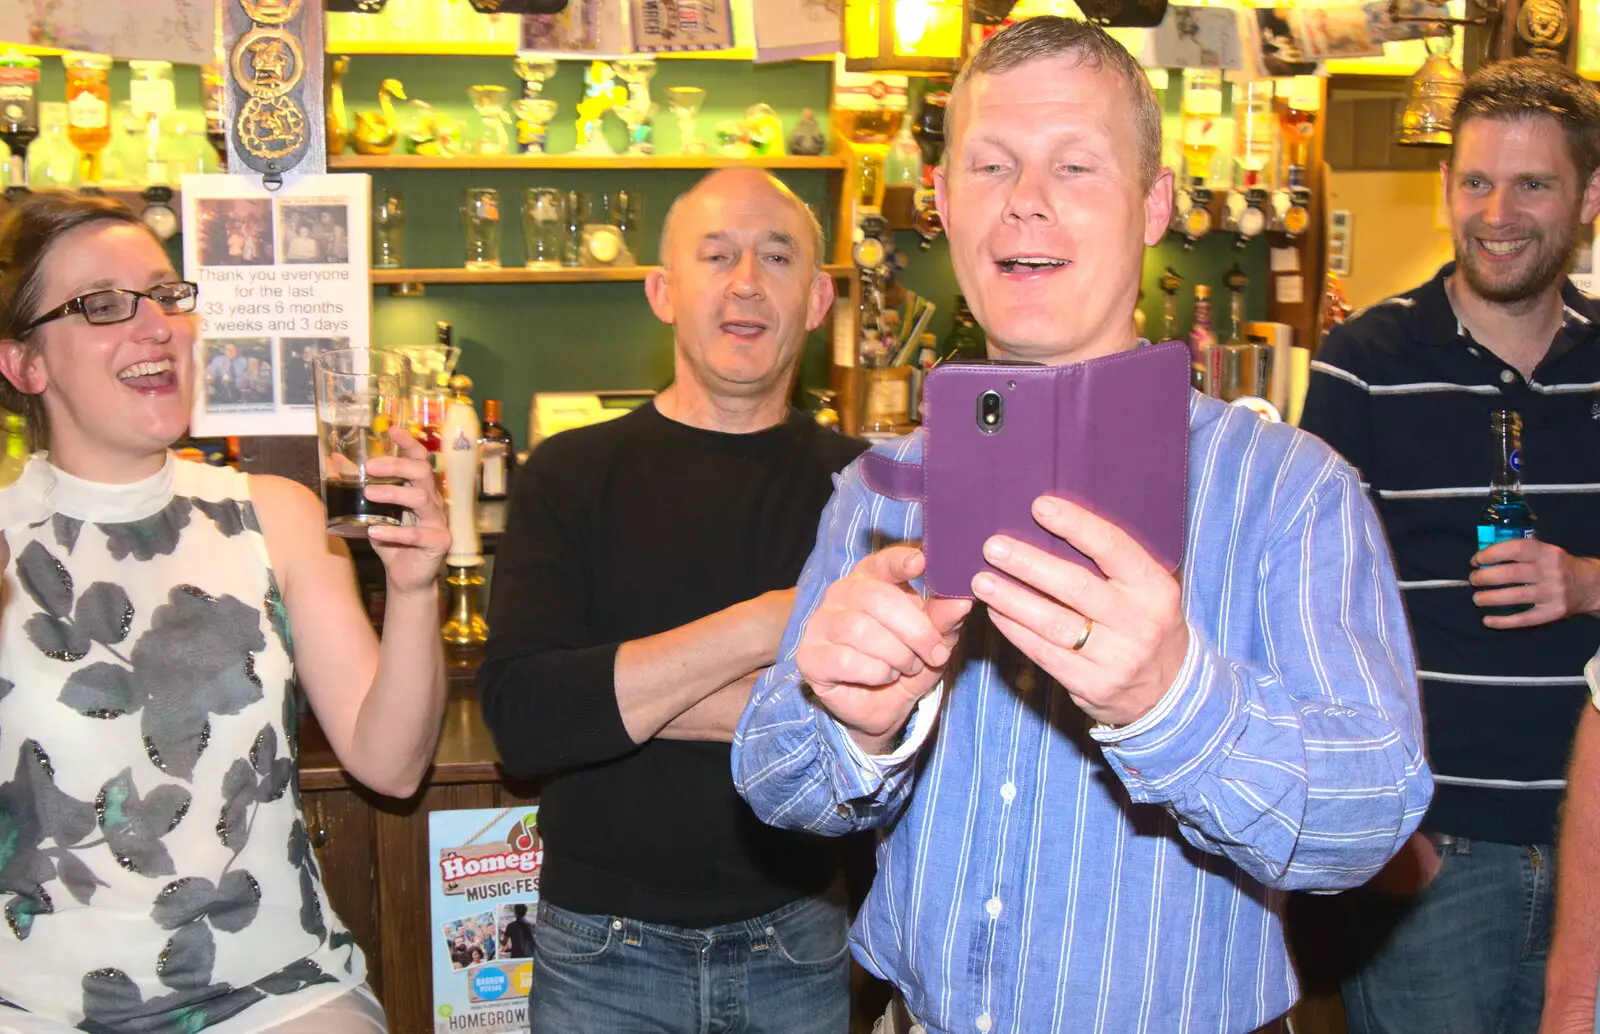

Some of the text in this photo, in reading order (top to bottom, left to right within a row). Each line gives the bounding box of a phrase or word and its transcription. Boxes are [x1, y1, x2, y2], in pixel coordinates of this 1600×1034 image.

[198, 268, 349, 284] Thank you everyone
[234, 284, 314, 297] for the last
[205, 301, 344, 317] 33 years 6 months
[201, 318, 349, 333] 3 weeks and 3 days
